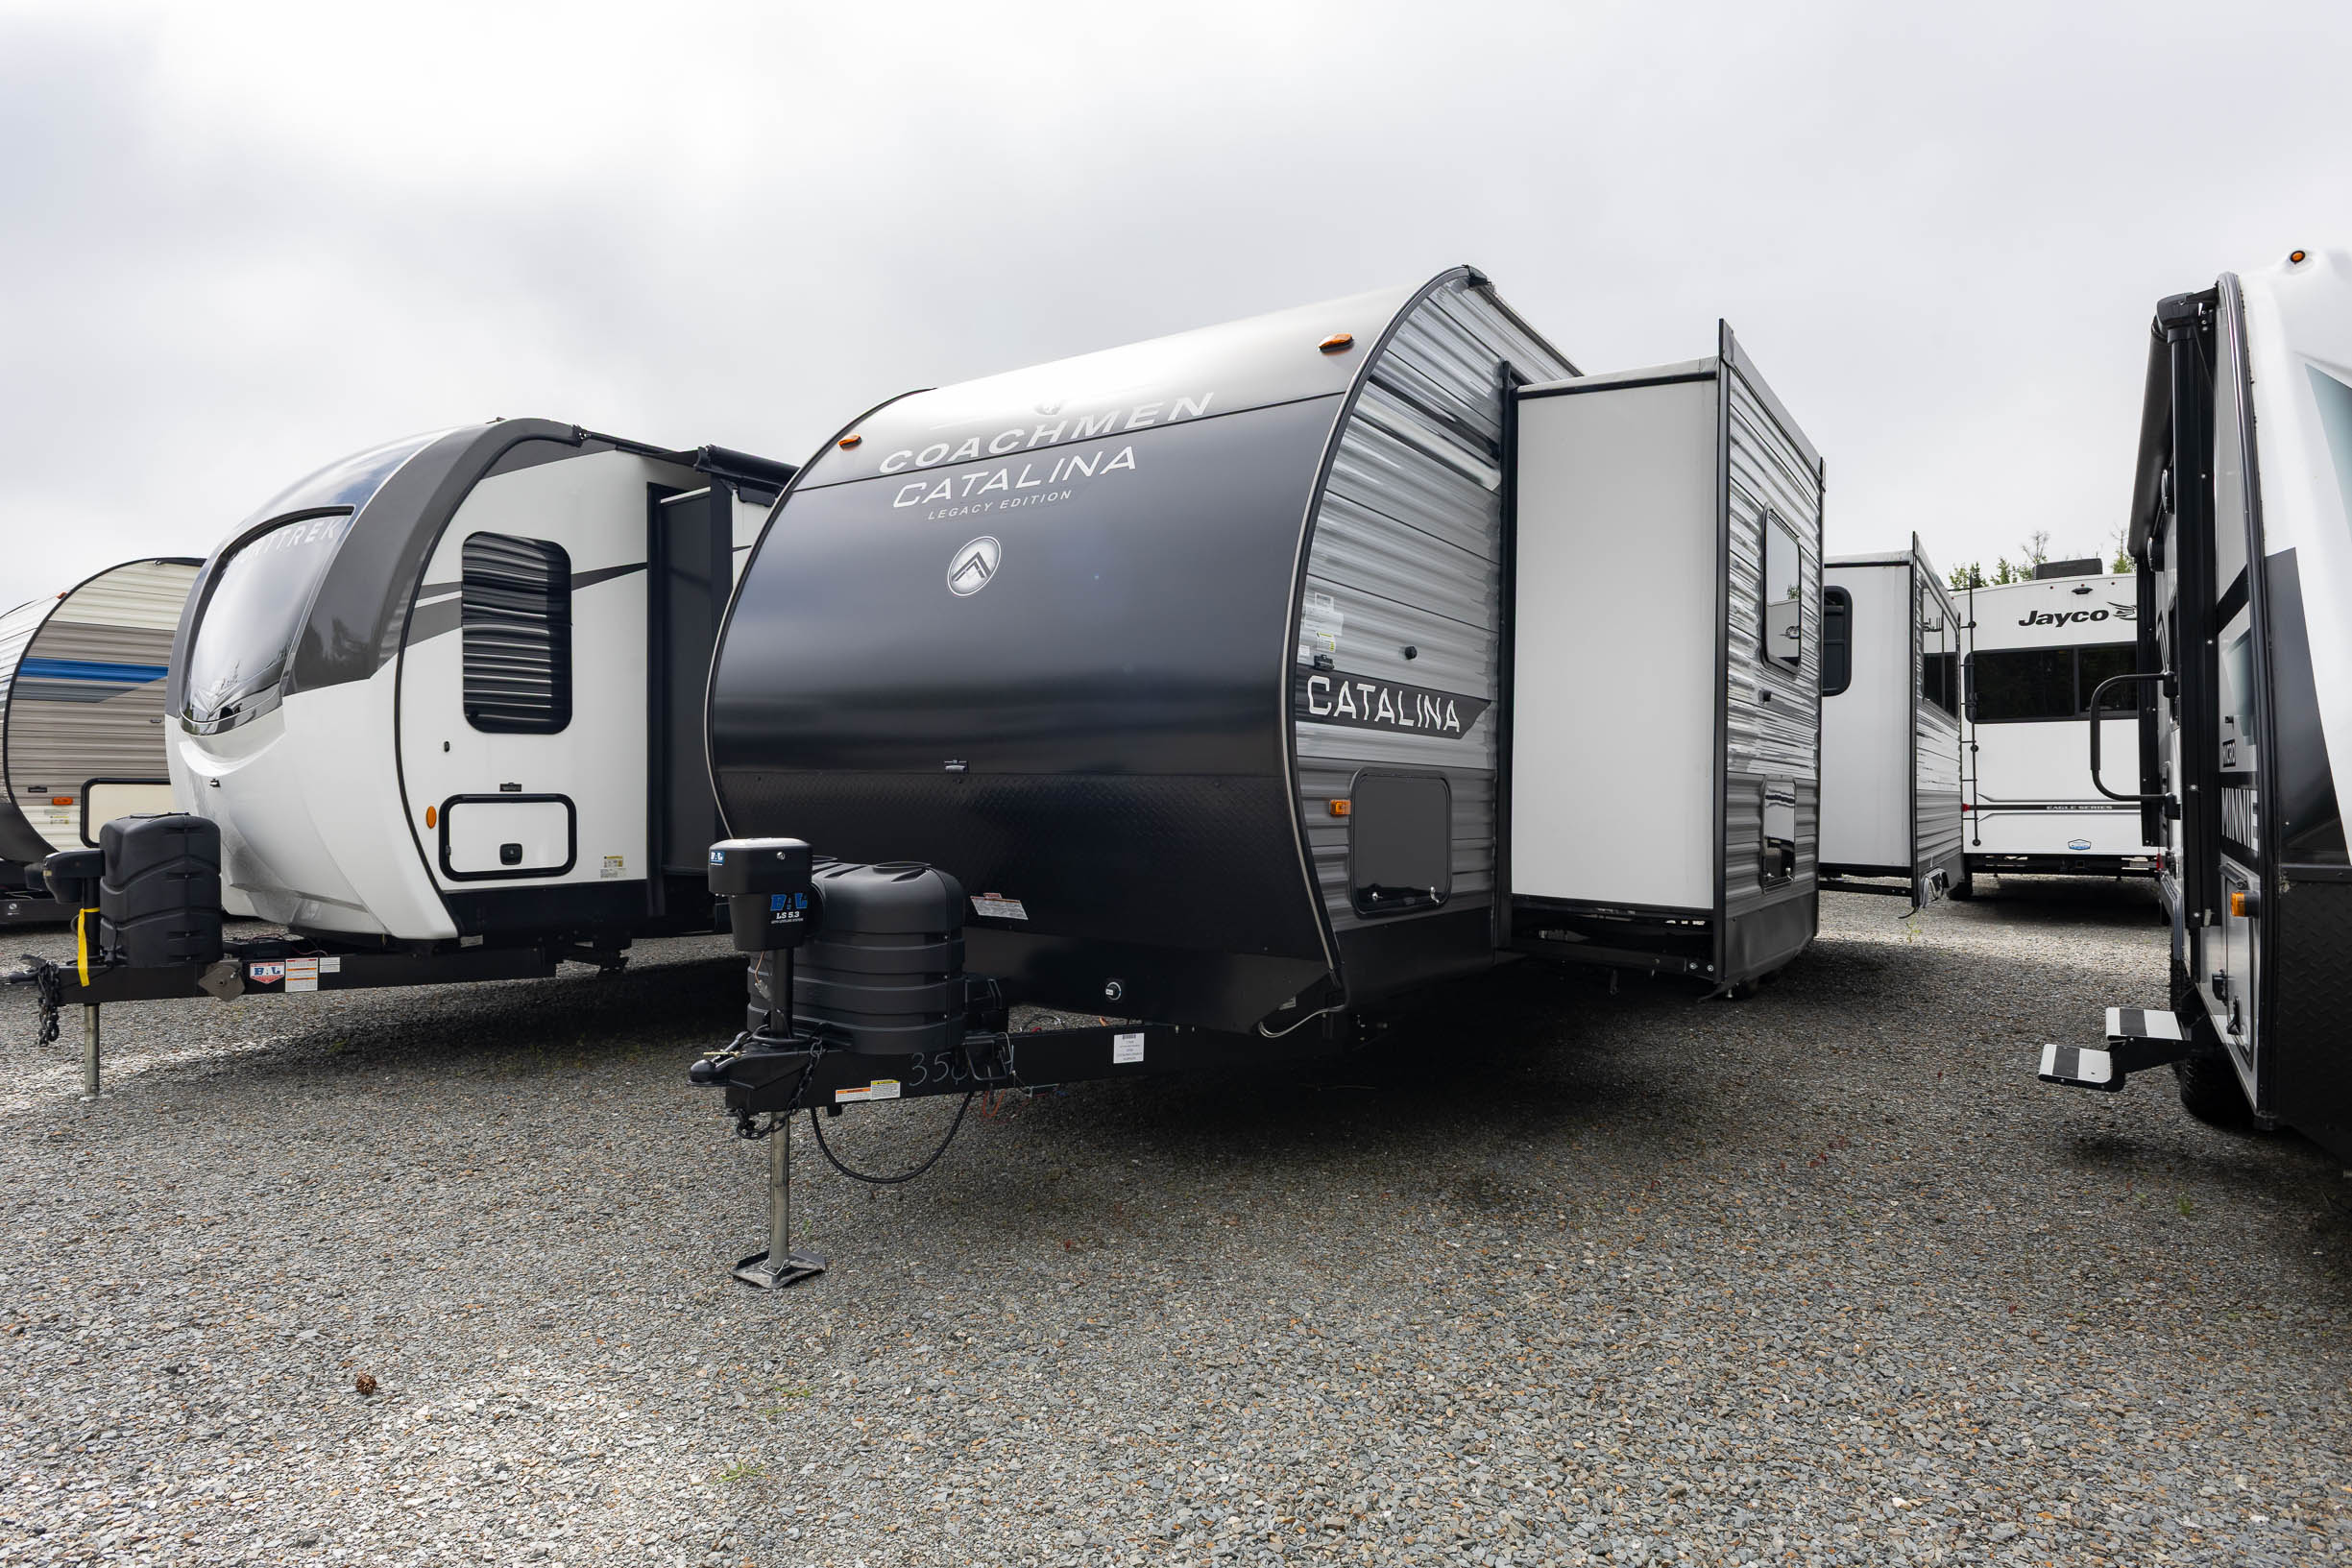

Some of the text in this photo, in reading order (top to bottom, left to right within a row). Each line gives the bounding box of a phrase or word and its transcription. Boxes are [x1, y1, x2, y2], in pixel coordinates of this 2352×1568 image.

[879, 392, 1215, 474] COACHMEN
[893, 446, 1136, 508] CATALINA
[928, 490, 1072, 520] LEGACY EDITION
[2018, 609, 2110, 628] Jayco
[1307, 675, 1460, 733] CATALINA
[776, 911, 788, 920] LS
